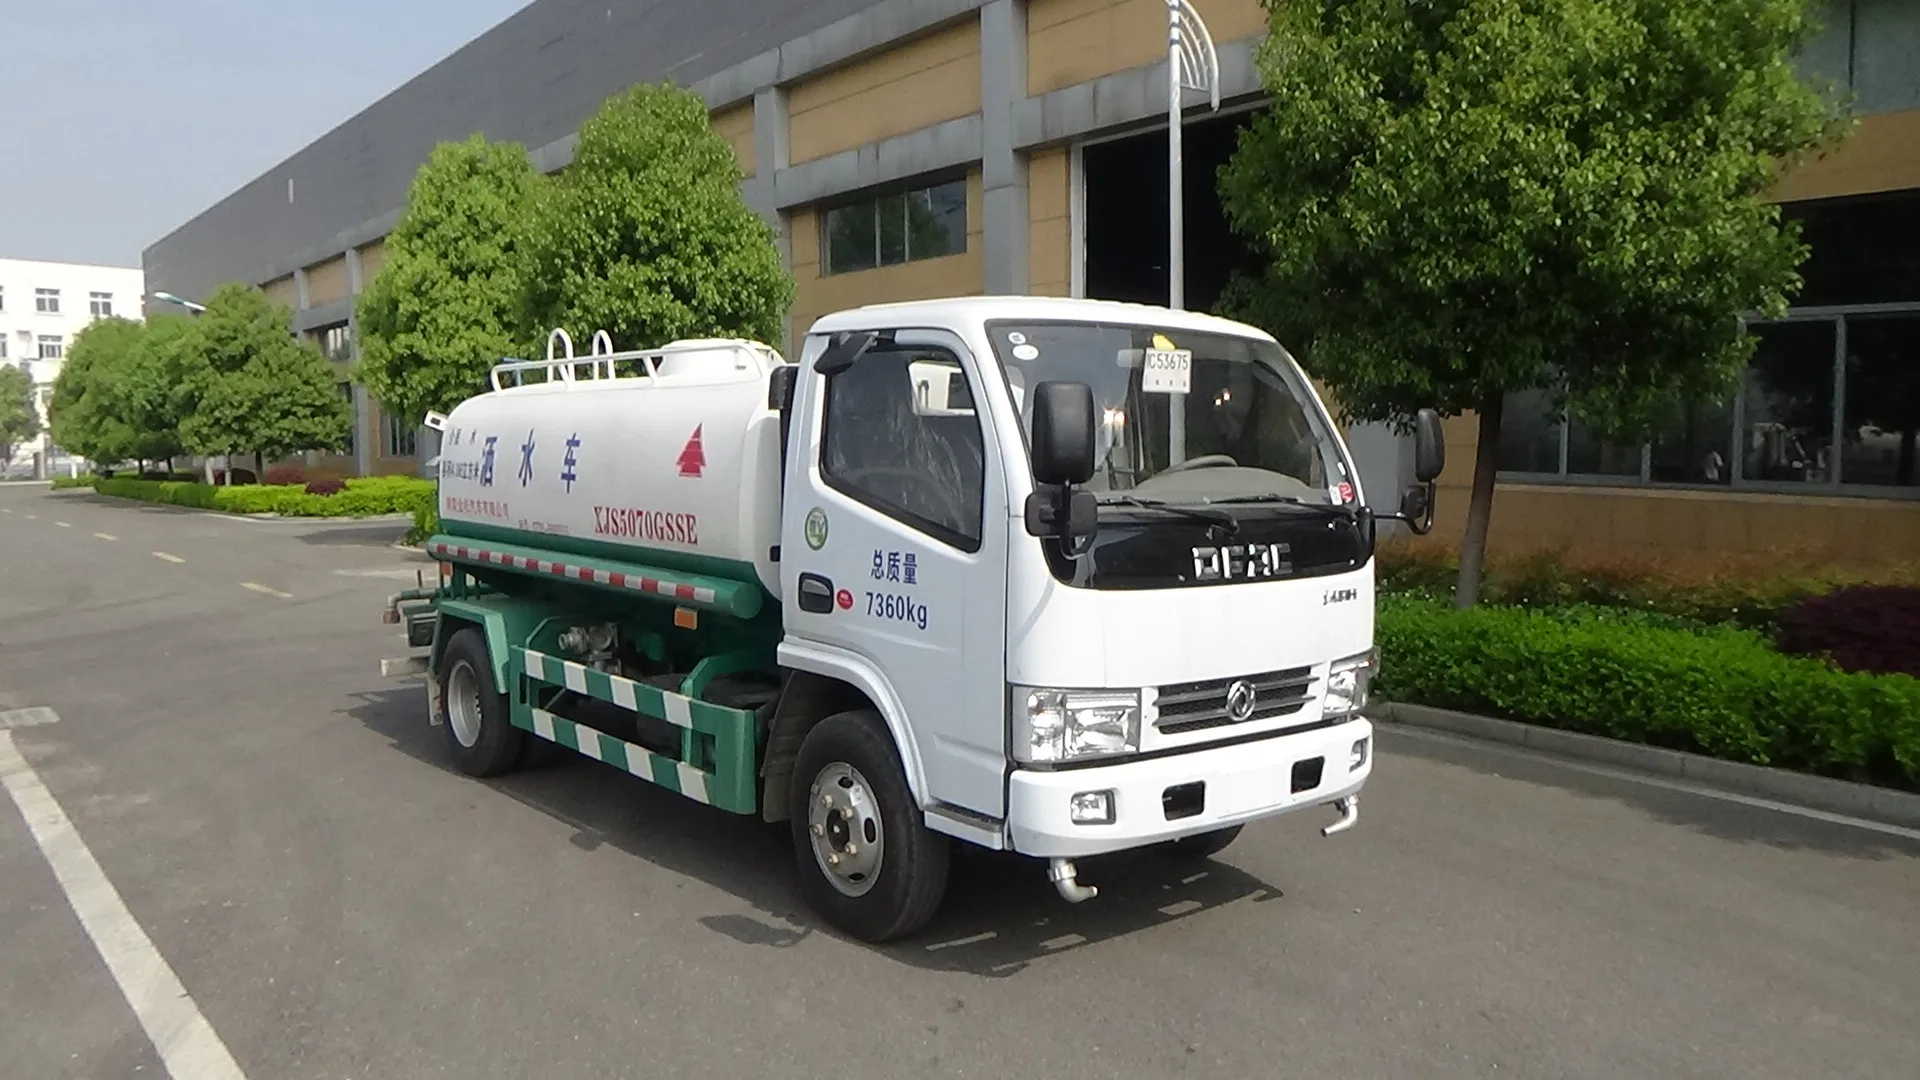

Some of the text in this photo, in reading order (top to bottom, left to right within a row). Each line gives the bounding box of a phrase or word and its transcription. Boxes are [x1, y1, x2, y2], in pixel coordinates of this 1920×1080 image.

[480, 428, 581, 494] 洒水车
[593, 505, 698, 546] XJS5070GSSE
[870, 549, 918, 585] 总质量
[865, 591, 927, 630] 7360kg
